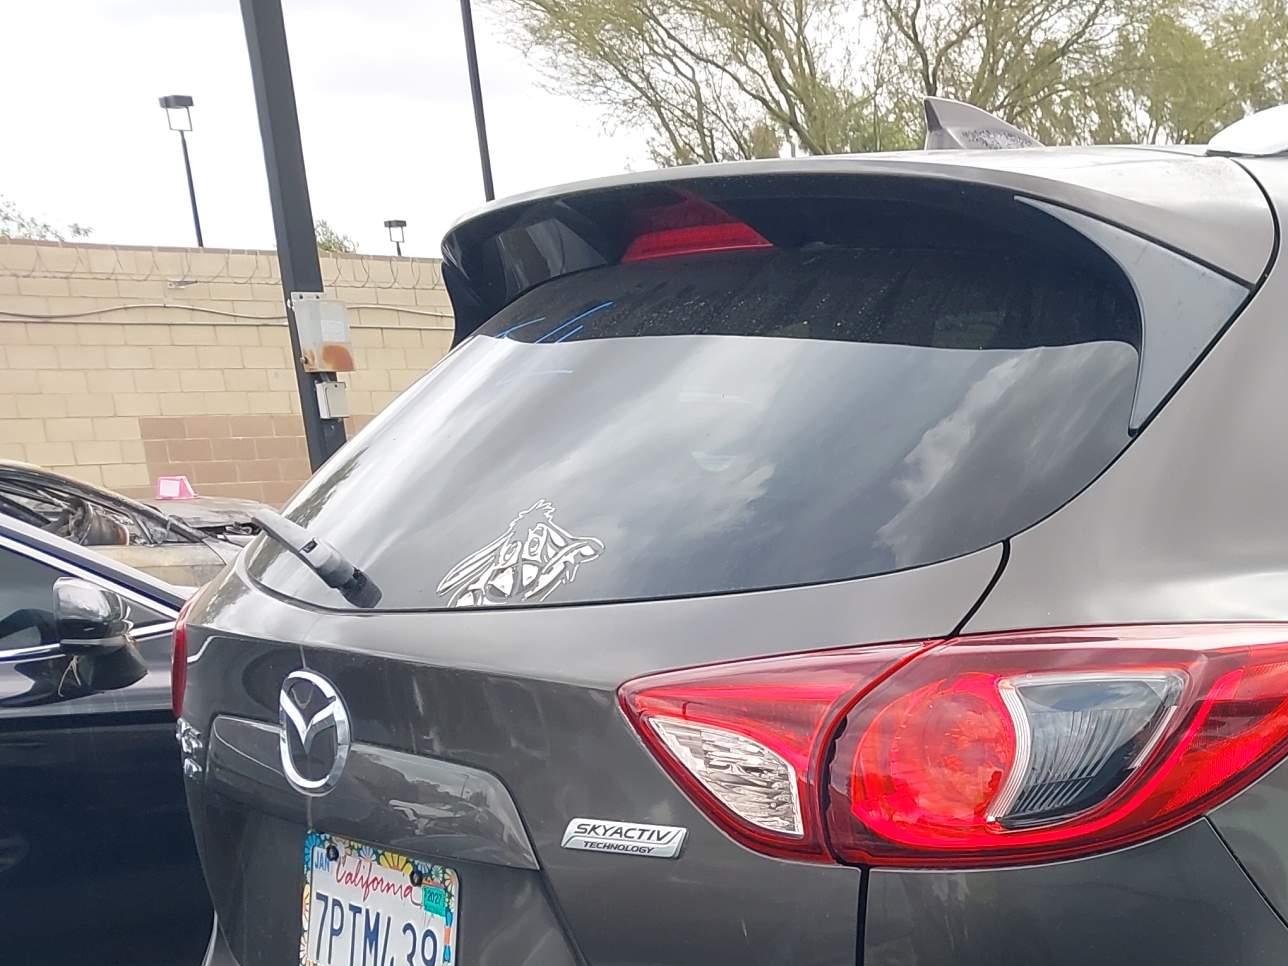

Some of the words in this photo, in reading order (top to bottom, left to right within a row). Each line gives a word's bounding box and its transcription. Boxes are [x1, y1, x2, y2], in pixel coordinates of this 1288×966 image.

[574, 823, 672, 841] SKYACTIV
[583, 841, 655, 854] TECHNOLOGY
[314, 851, 330, 872] JAN
[335, 857, 422, 907] California
